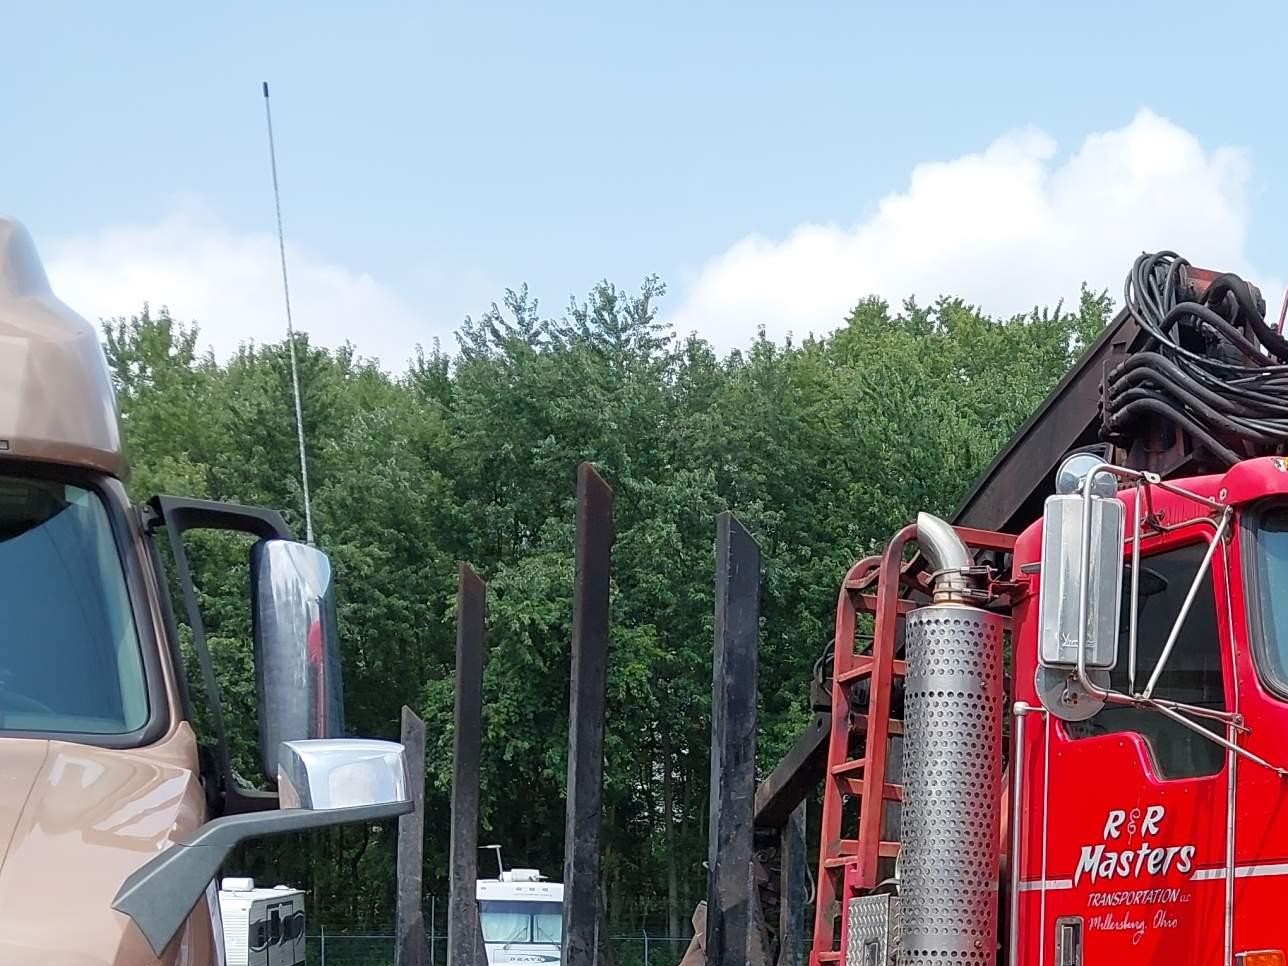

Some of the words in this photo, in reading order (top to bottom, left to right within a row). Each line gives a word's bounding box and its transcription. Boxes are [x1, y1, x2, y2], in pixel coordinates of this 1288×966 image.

[1103, 809, 1126, 841] R
[1141, 805, 1165, 838] R
[1074, 842, 1196, 888] Masters
[1087, 888, 1181, 907] TRANSPORTATION
[1152, 909, 1178, 929] Ohio
